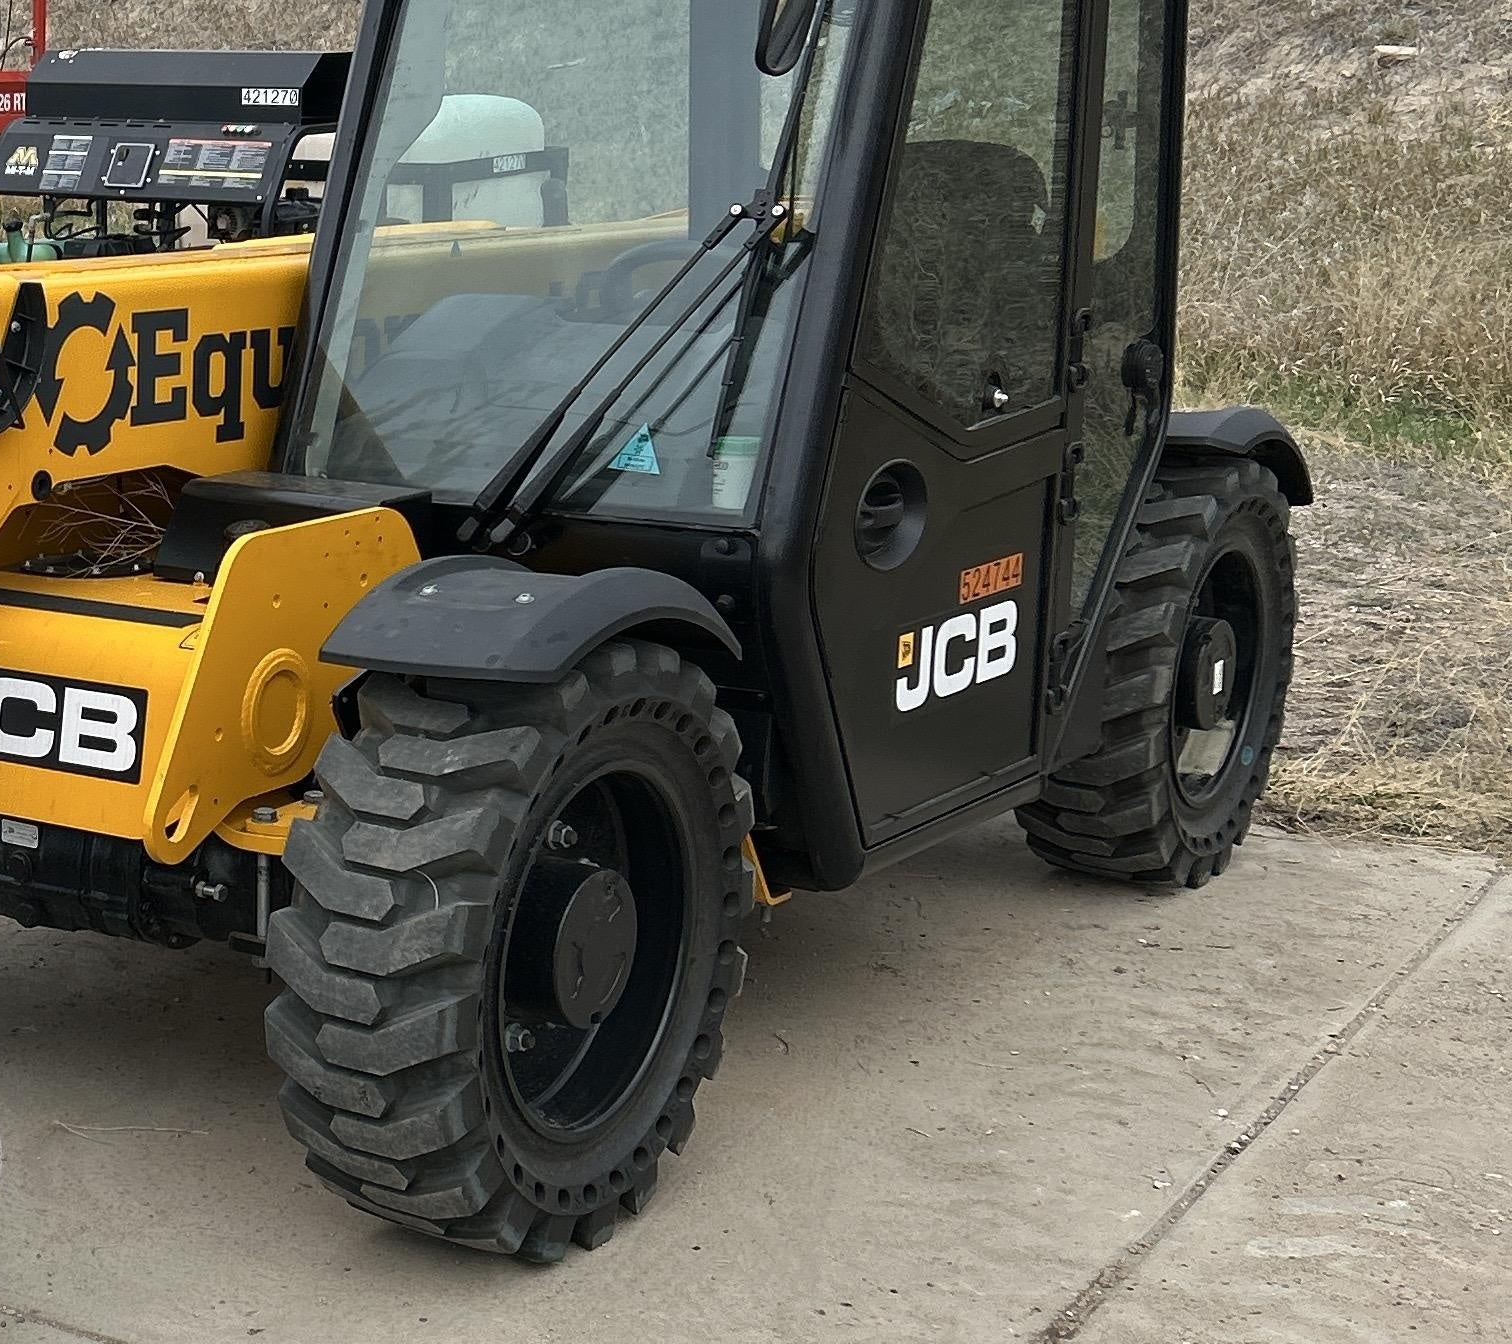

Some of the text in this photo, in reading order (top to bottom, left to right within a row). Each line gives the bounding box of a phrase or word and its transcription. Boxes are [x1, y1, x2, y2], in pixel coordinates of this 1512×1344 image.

[243, 89, 298, 105] 421270
[130, 307, 296, 444] Equ
[959, 555, 1022, 602] 524744
[896, 599, 1018, 713] JCB
